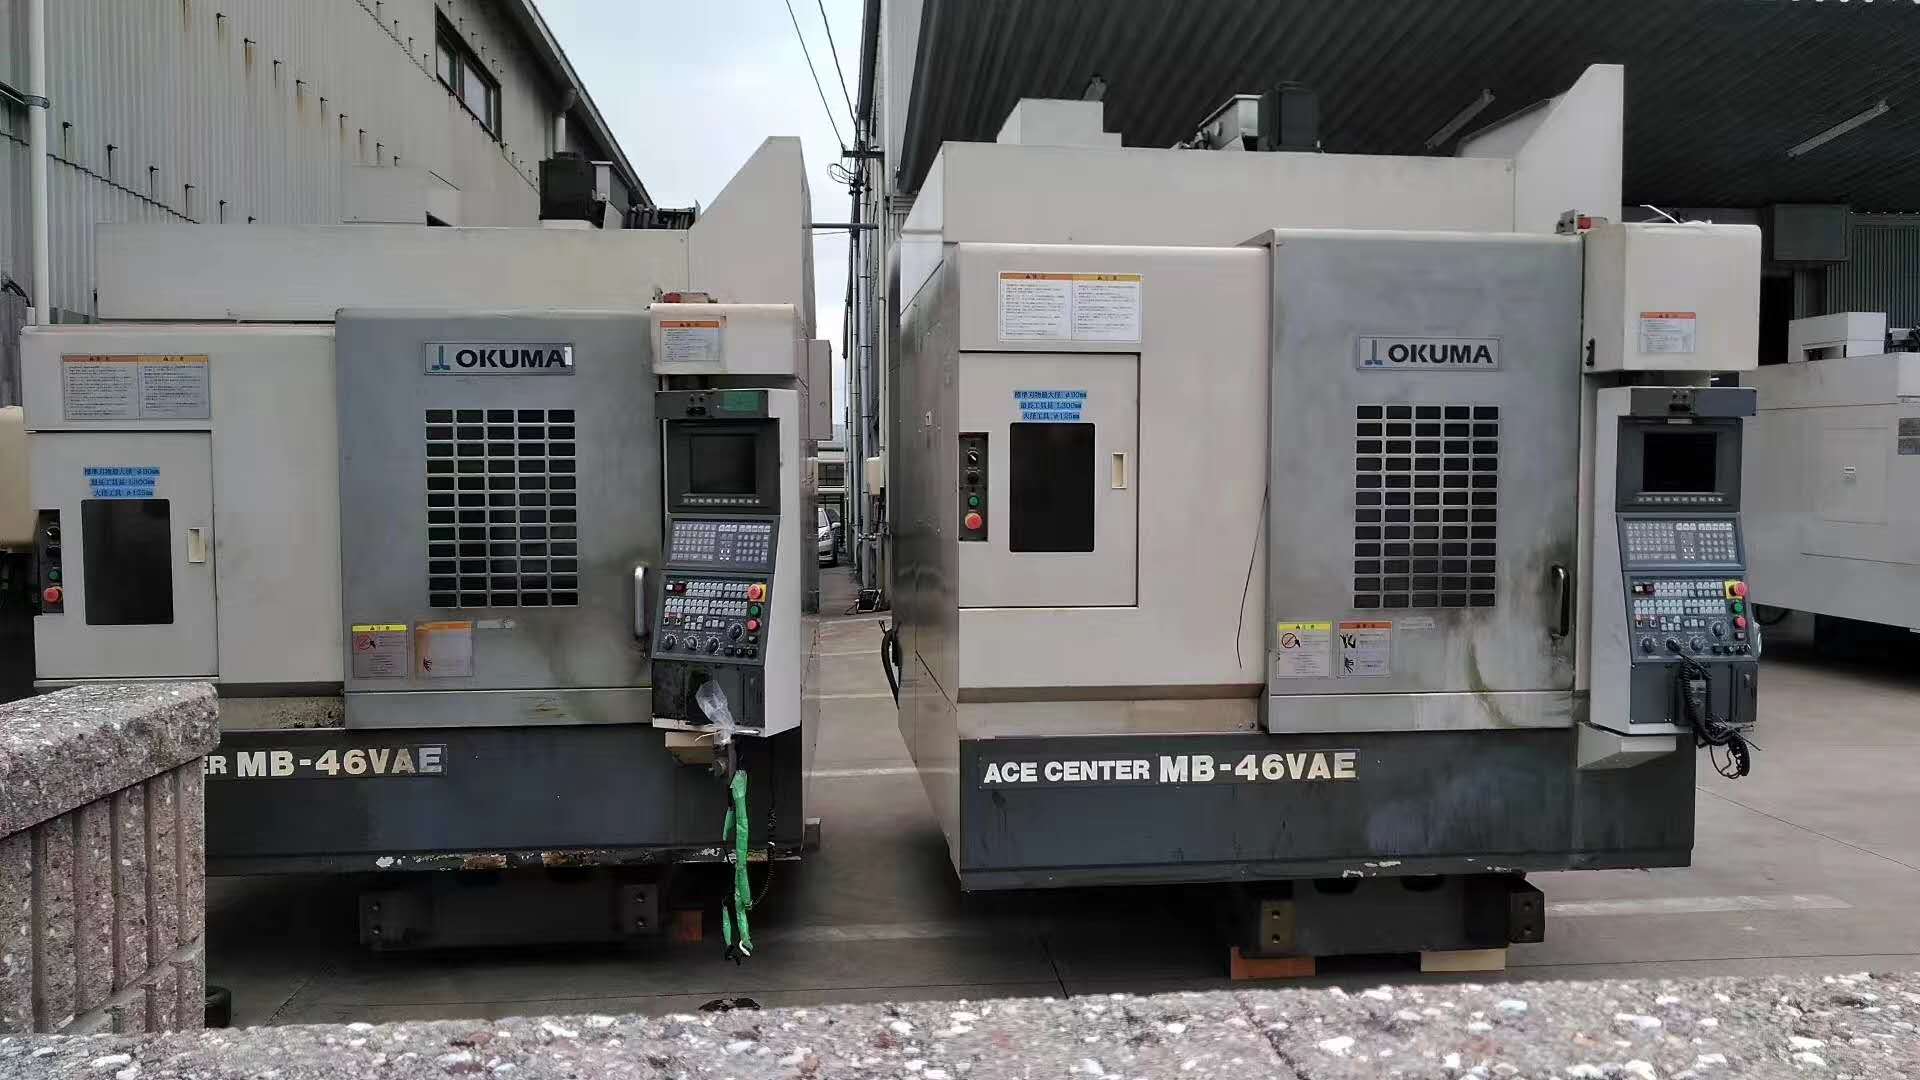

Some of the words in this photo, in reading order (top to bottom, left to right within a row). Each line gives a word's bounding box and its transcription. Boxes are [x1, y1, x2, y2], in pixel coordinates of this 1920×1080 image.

[455, 349, 566, 368] OKUMA
[1388, 343, 1493, 364] OKUMA
[236, 747, 443, 777] MB-46VAE
[984, 761, 1038, 784] ACE
[1044, 760, 1151, 782] CENTER
[1160, 752, 1356, 782] MB-46VAE
